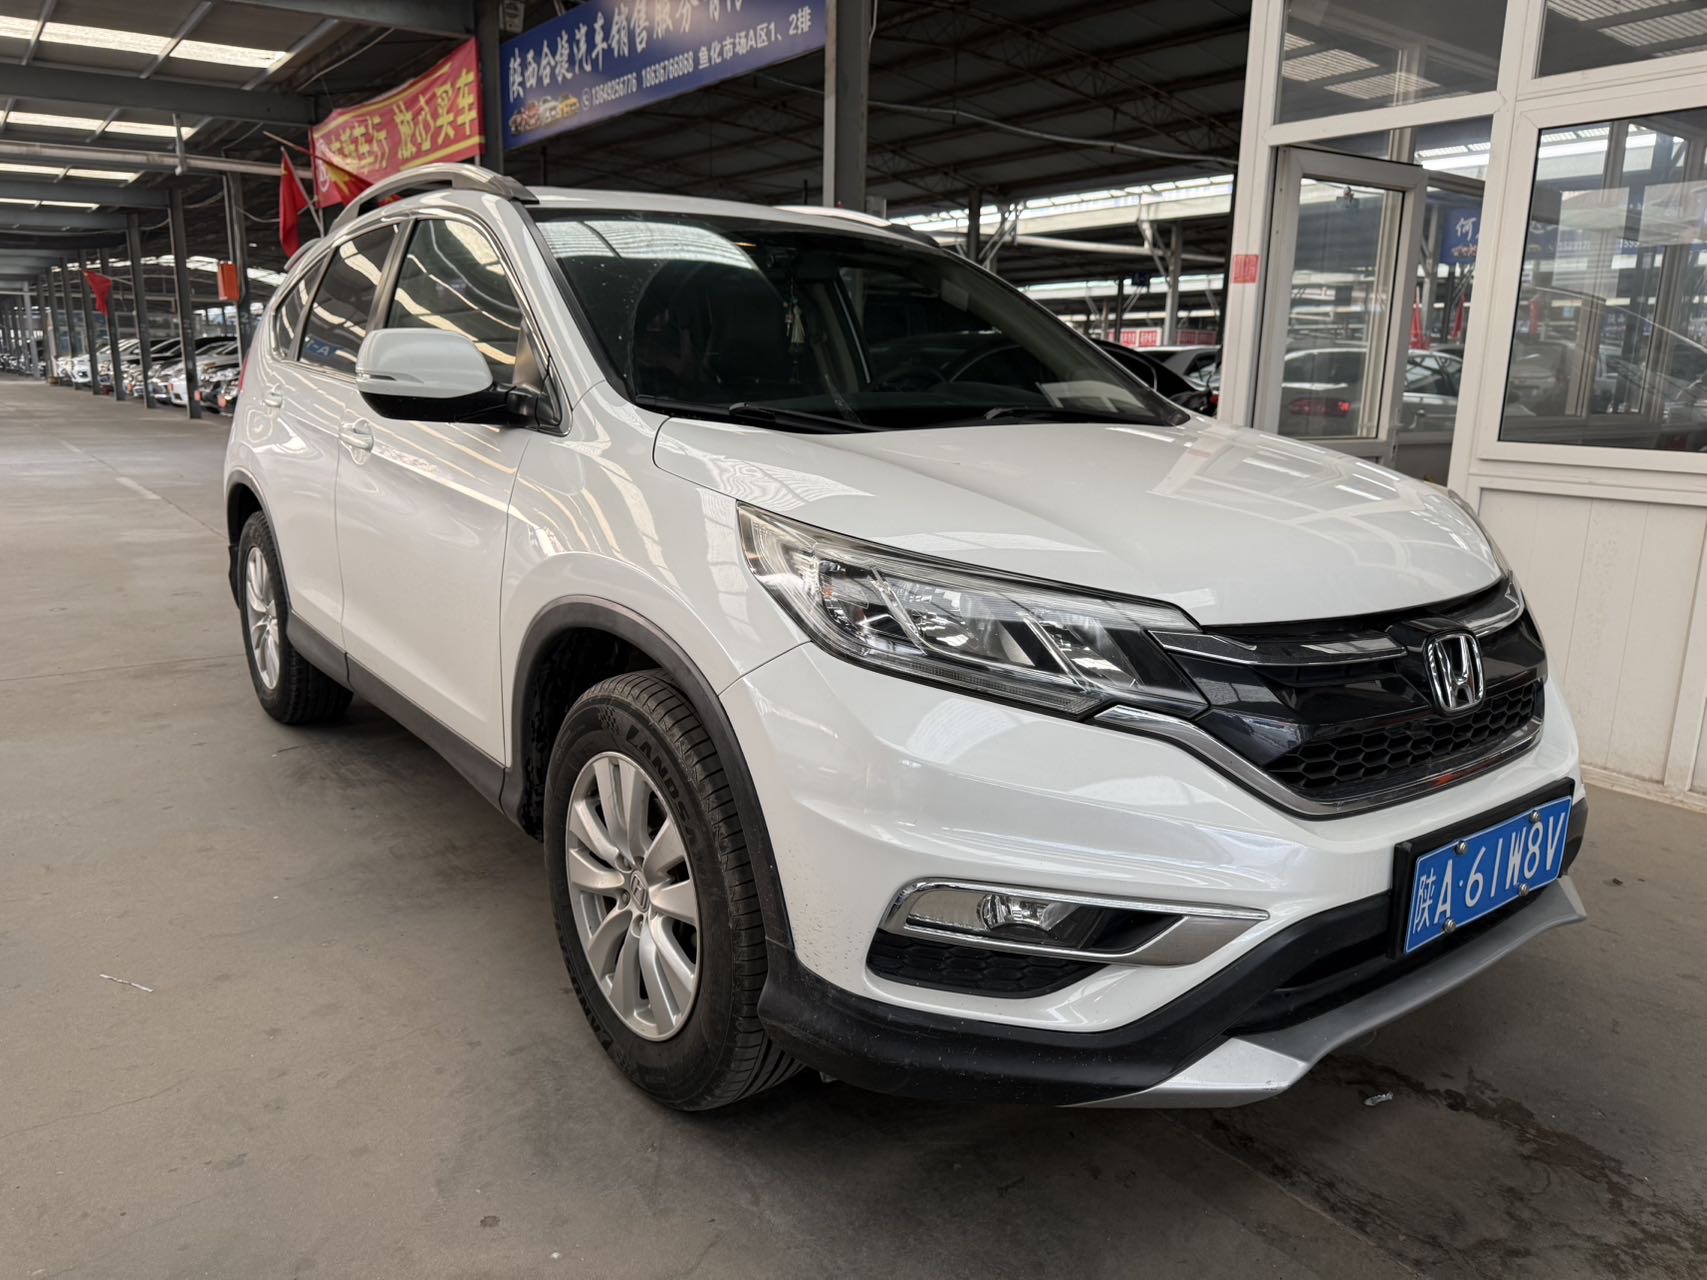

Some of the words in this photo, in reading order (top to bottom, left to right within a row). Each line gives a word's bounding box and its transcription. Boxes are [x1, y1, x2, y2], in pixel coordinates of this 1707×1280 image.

[508, 0, 743, 103] 陕西合捷汽车销售服务
[1455, 217, 1480, 241] 何
